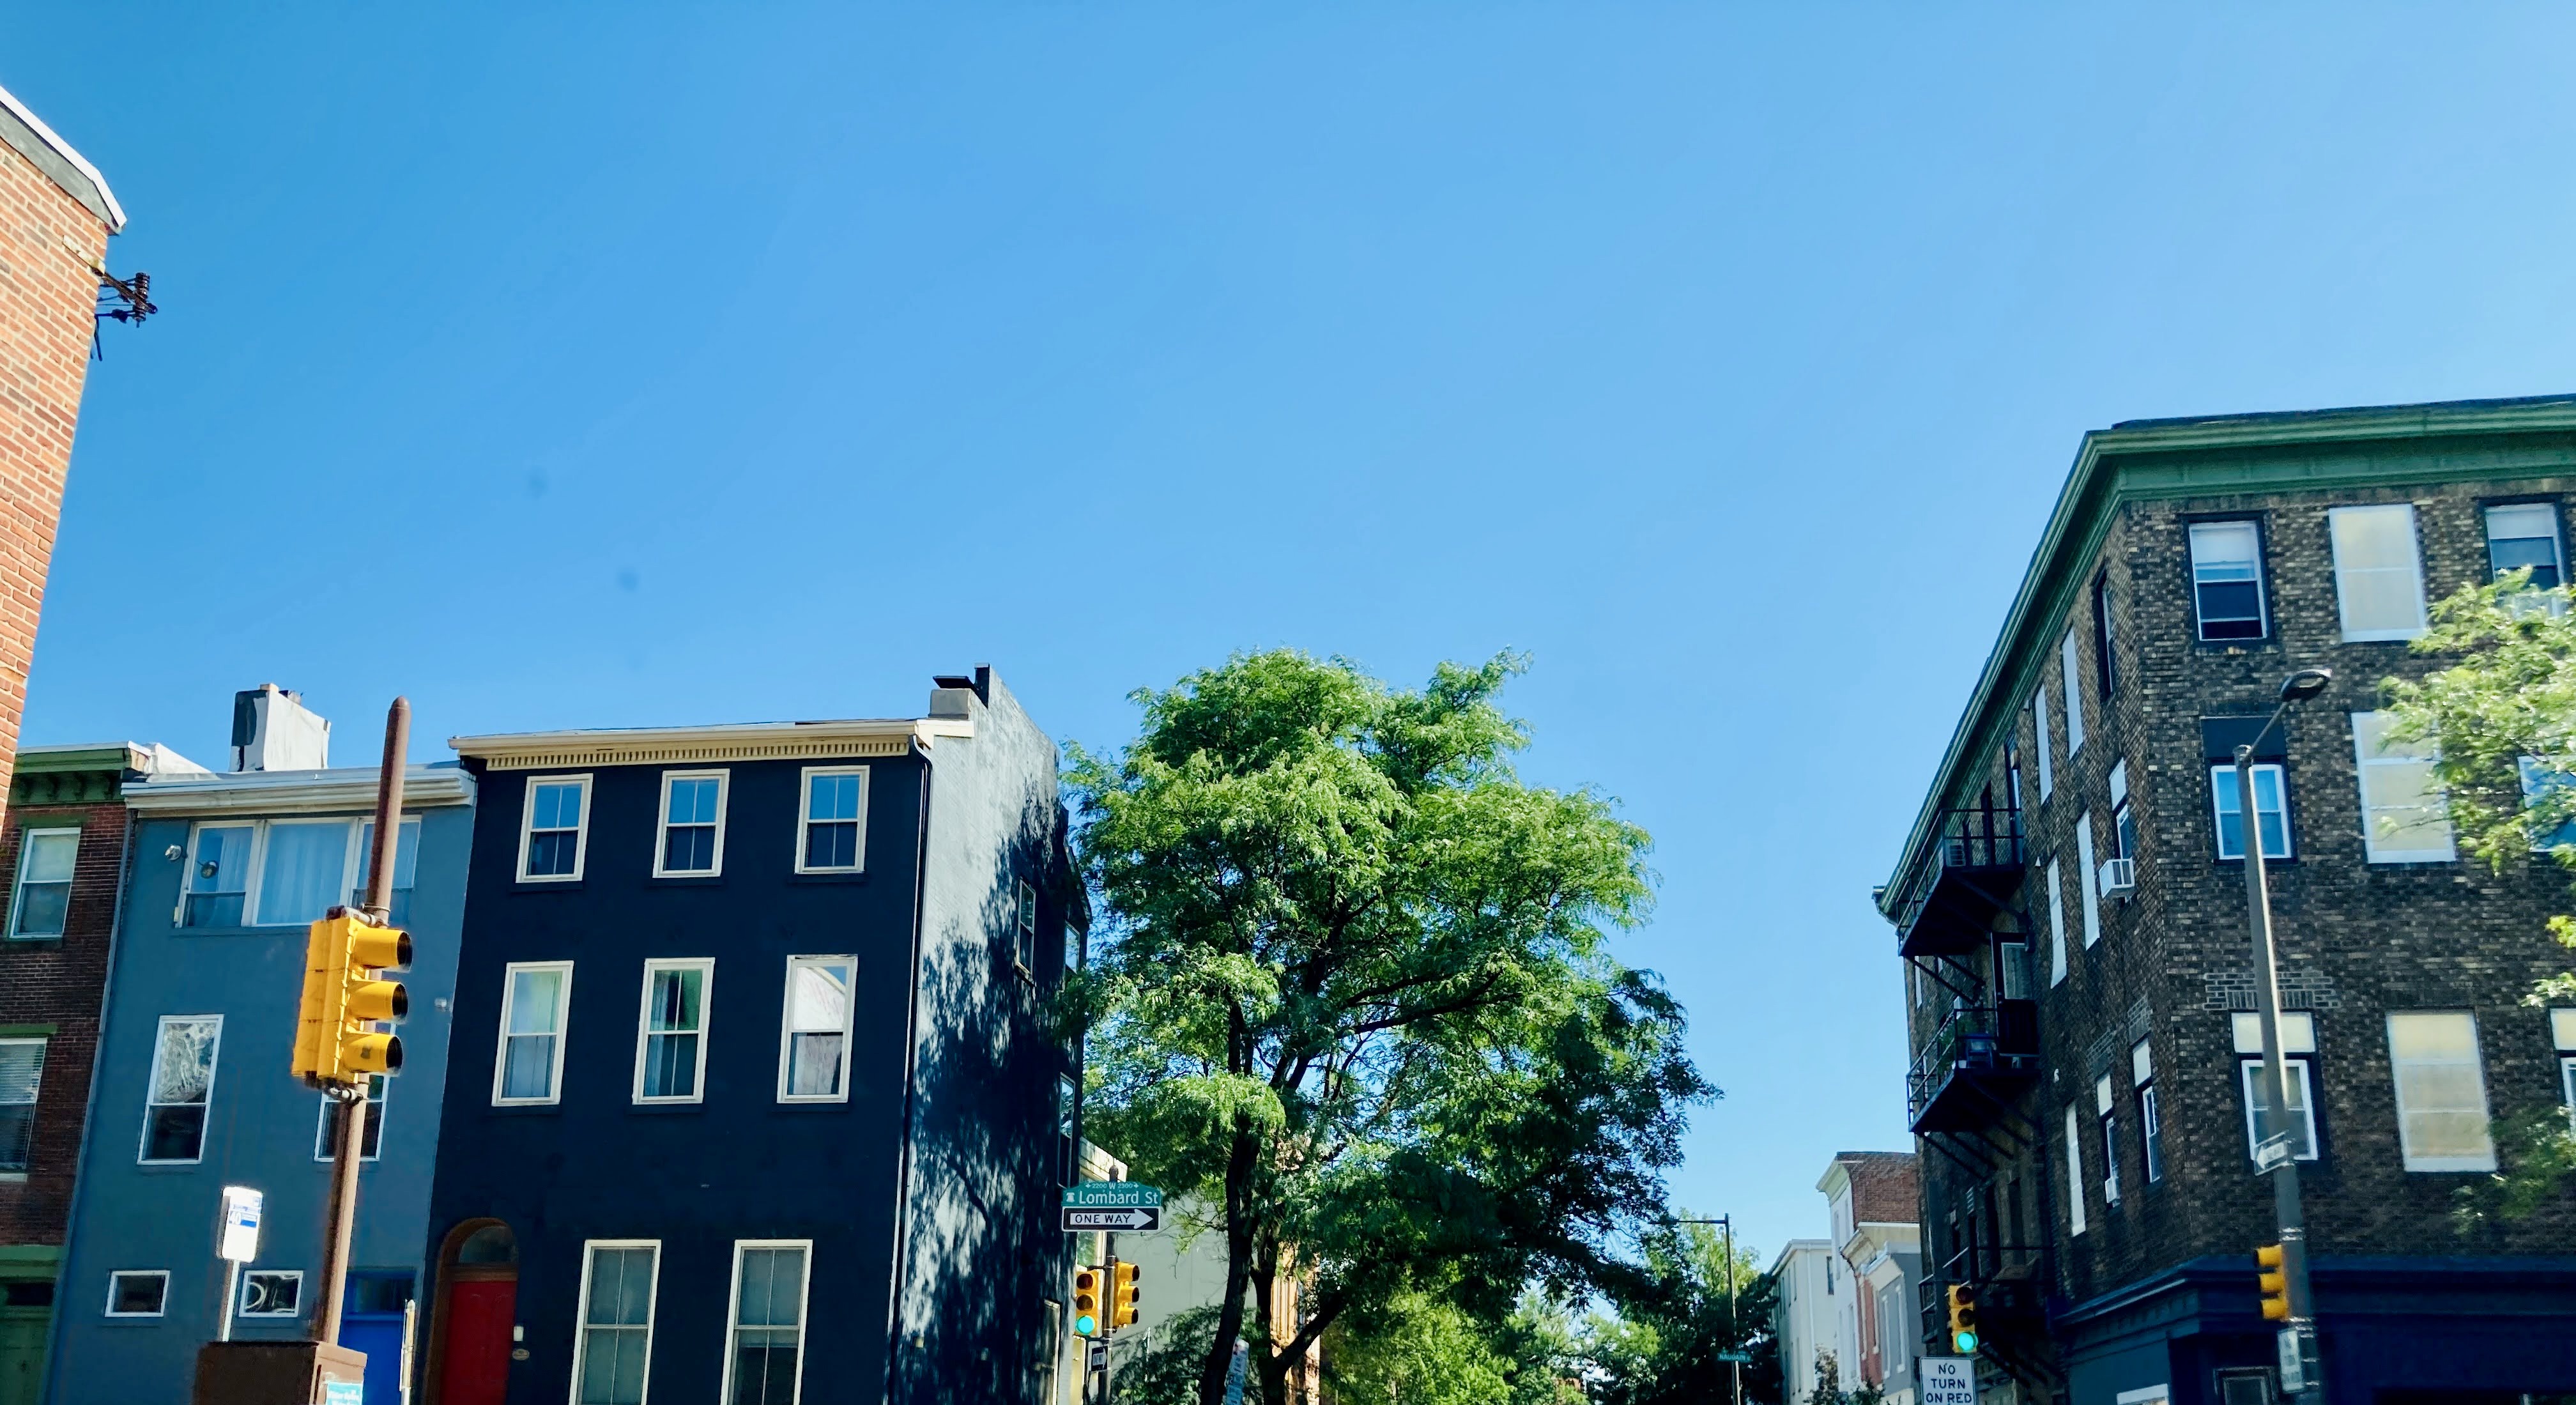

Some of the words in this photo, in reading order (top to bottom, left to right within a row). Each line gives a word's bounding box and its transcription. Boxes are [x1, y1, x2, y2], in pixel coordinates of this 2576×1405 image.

[1079, 1190, 1139, 1204] Lombard
[1145, 1191, 1158, 1204] St
[1075, 1214, 1100, 1224] ONE
[1105, 1214, 1131, 1224] WAY
[1938, 1364, 1956, 1374] NO
[1931, 1378, 1966, 1389] TURN
[1926, 1392, 1943, 1403] ON
[1947, 1392, 1972, 1404] RED
